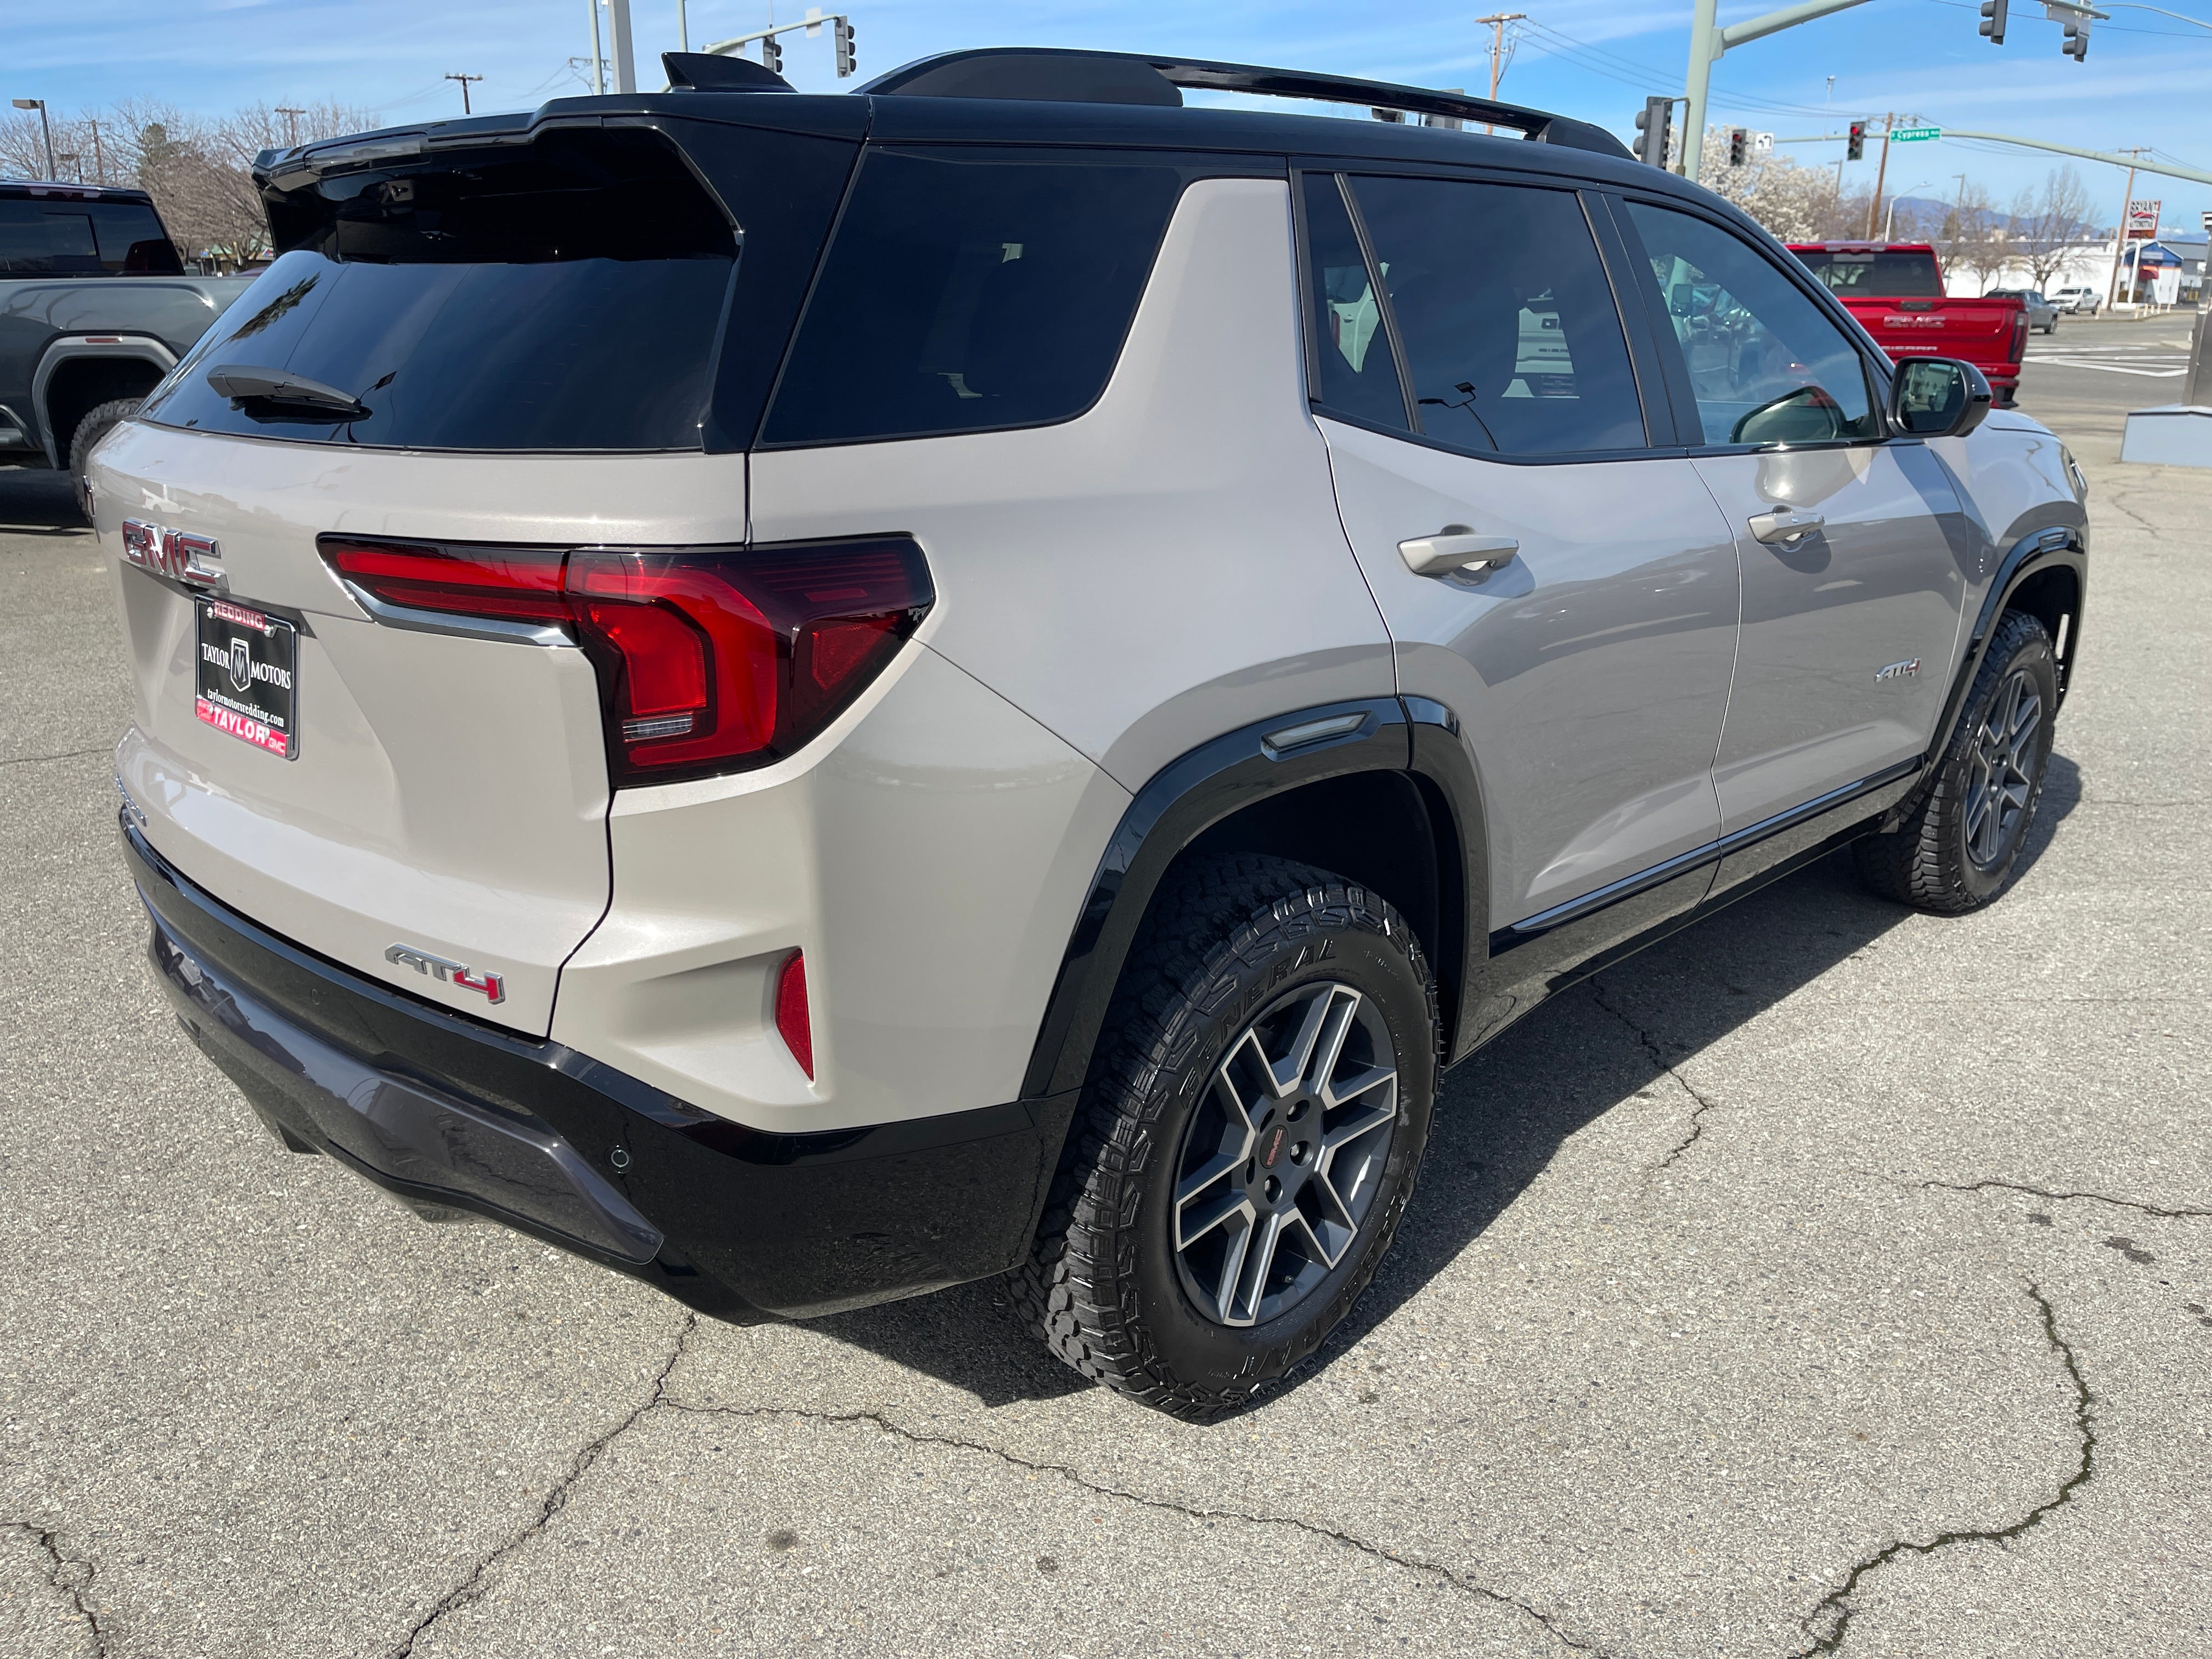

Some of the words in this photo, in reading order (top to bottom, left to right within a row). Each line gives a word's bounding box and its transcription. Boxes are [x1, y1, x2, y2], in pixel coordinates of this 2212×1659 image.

[1897, 130, 1929, 140] Cypress
[1883, 315, 1946, 328] GMC
[122, 517, 230, 592] GMC
[215, 602, 263, 629] REDDING
[201, 643, 230, 670] TAYLOR
[251, 660, 291, 690] MOTORS
[1874, 657, 1921, 682] AT4
[207, 688, 284, 727] taylormotorsredding.com
[213, 707, 267, 745] TAYLOR
[268, 737, 286, 753] GMC
[385, 942, 506, 1005] AT4
[1178, 939, 1336, 1109] GENERAL
[1266, 1128, 1283, 1165] GMC
